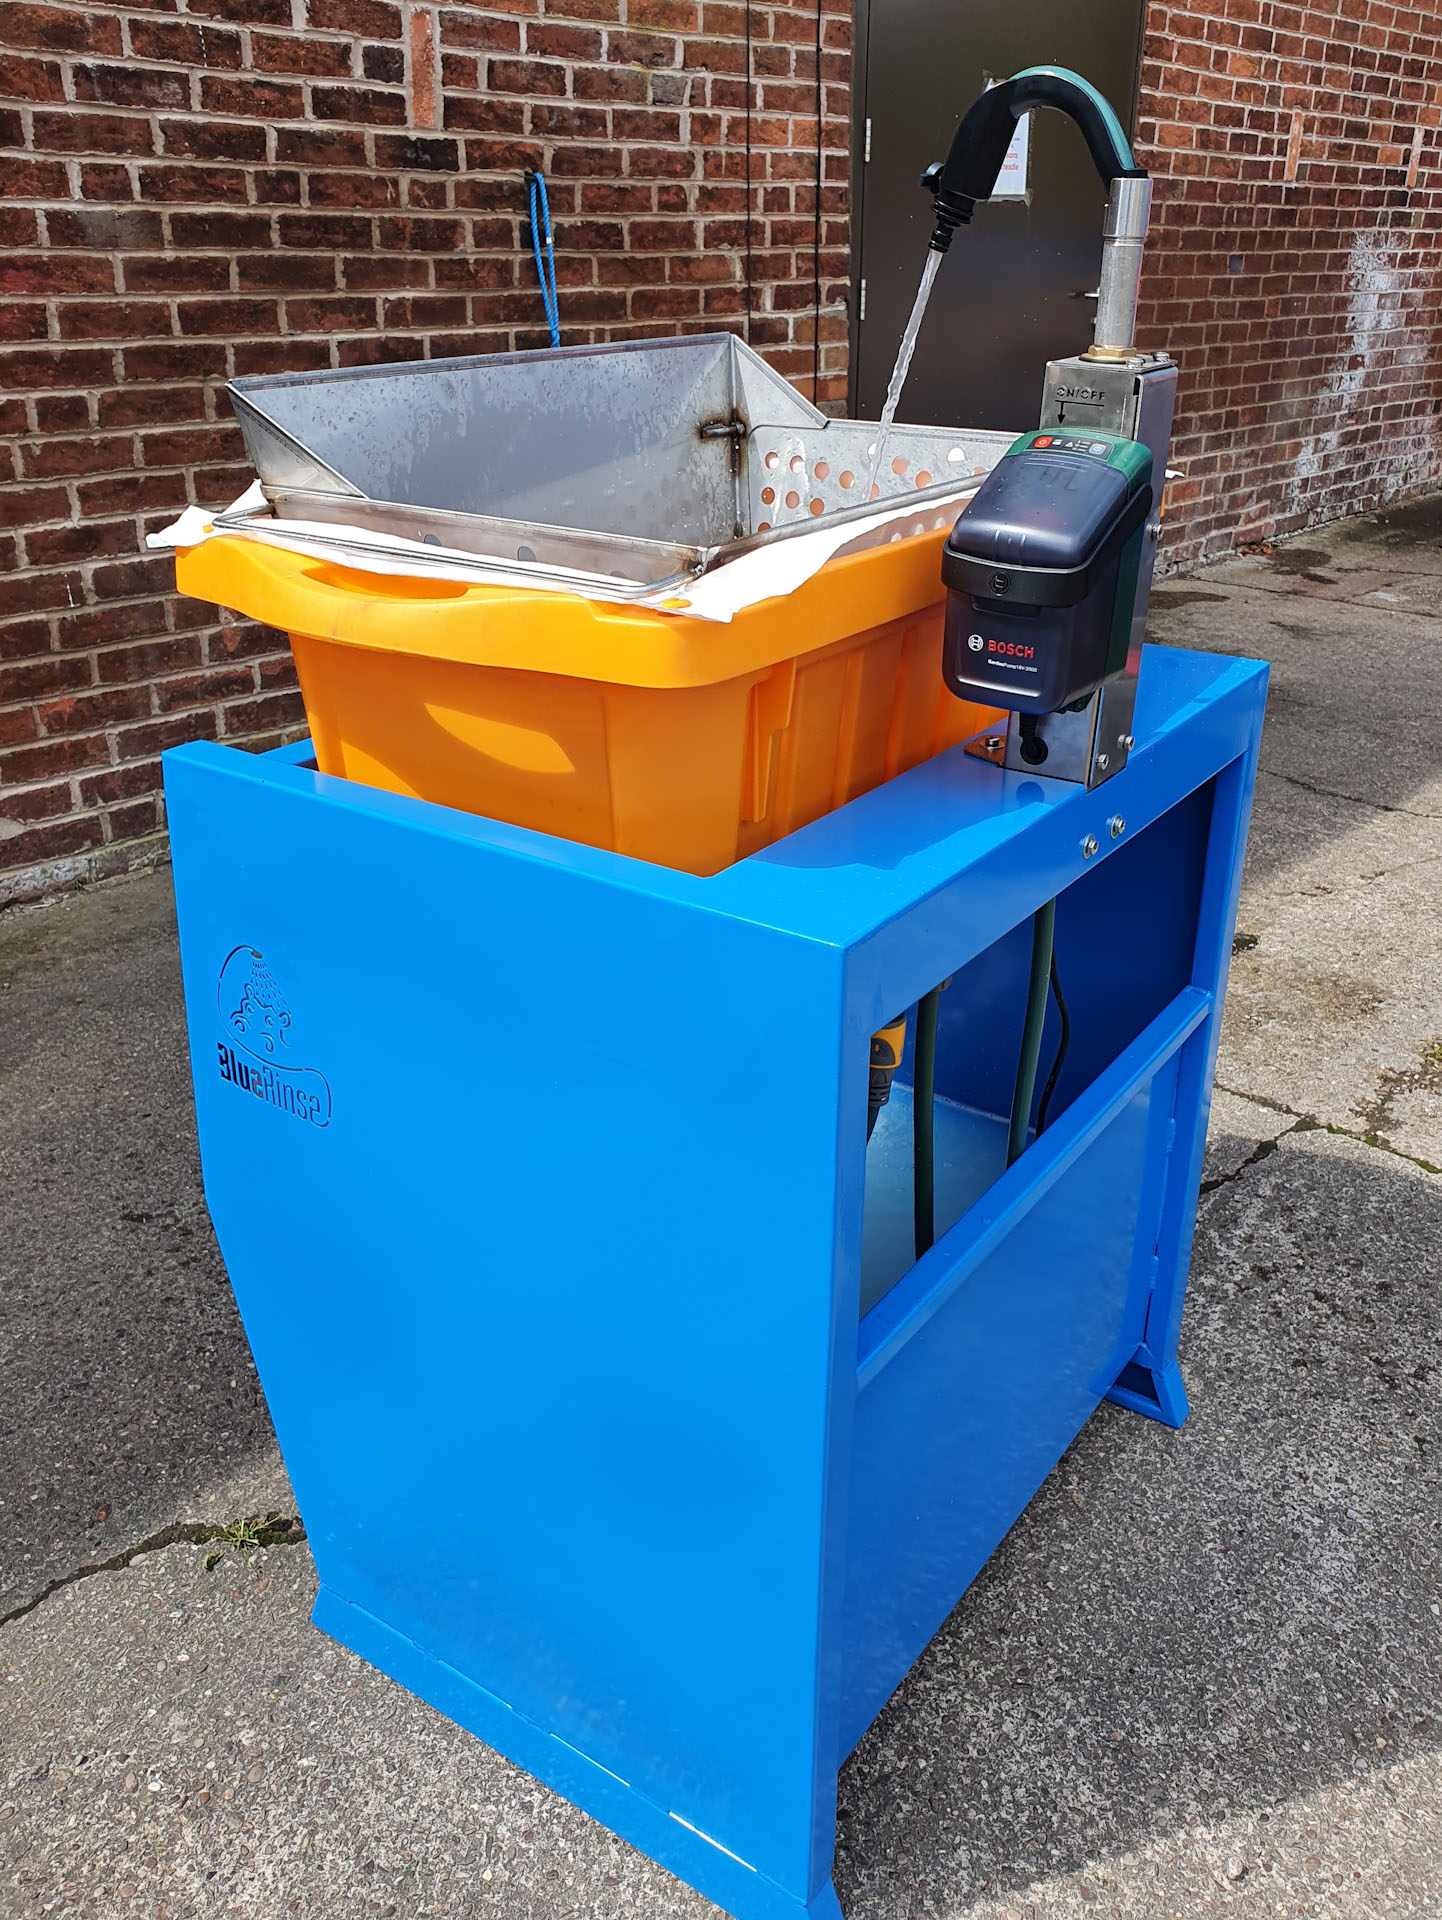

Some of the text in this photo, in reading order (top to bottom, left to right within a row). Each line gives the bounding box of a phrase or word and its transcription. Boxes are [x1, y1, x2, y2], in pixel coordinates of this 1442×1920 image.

[1056, 387, 1106, 400] ON/OFF
[987, 639, 1034, 659] BOSCH
[217, 1042, 329, 1128] BlueRinse
